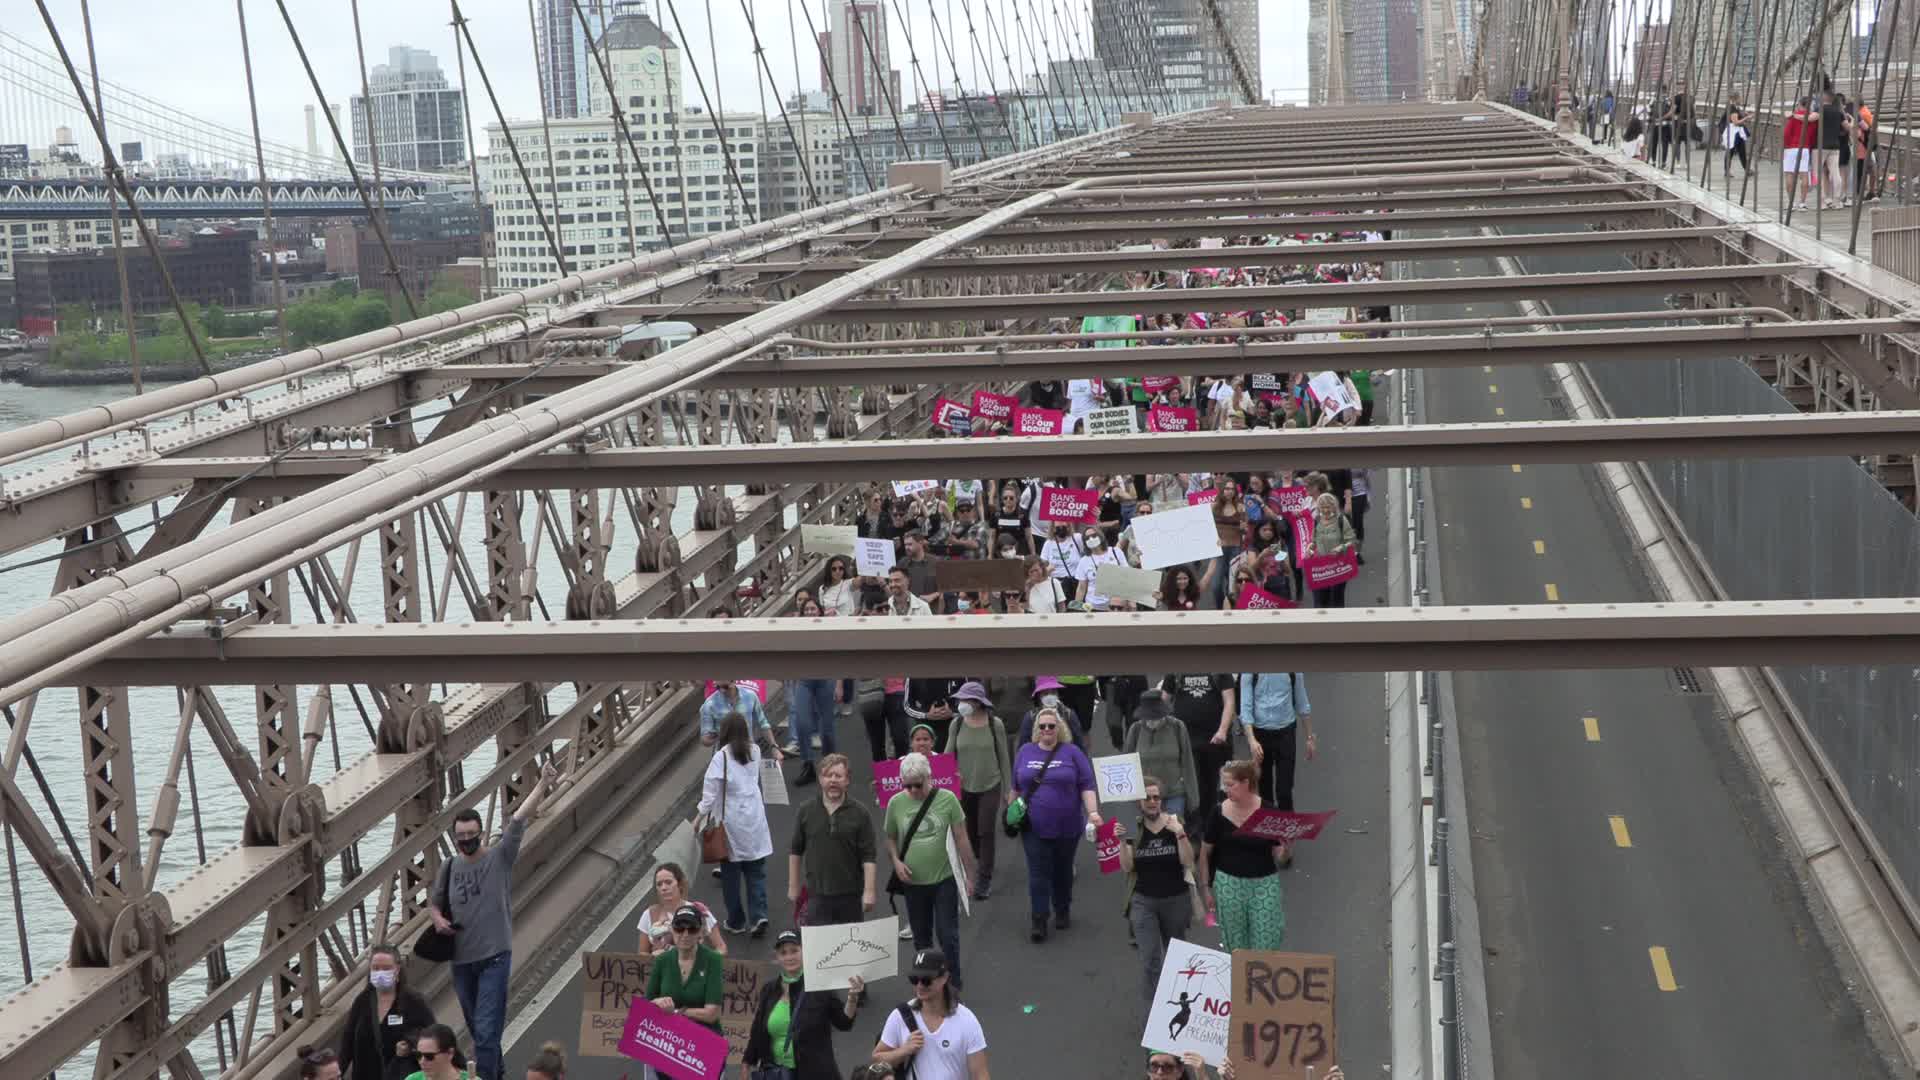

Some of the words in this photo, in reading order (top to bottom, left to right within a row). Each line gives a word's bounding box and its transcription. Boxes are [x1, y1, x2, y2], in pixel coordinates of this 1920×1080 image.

[980, 407, 1008, 416] BODIES
[1021, 412, 1043, 421] BANS
[1089, 411, 1103, 419] OUR
[1105, 409, 1129, 417] BODIES
[1036, 420, 1054, 428] OUR
[1090, 421, 1104, 429] OUR
[1105, 419, 1130, 428] CHOICE
[1051, 493, 1075, 502] BANS
[1281, 491, 1303, 499] BANS
[1050, 500, 1067, 508] OFF
[1068, 502, 1089, 511] OUR
[1049, 508, 1084, 517] BODIES
[1312, 569, 1336, 579] Health
[1251, 593, 1280, 608] BANS
[818, 939, 851, 967] never
[915, 952, 925, 965] N
[1245, 960, 1330, 1004] ROE
[1203, 997, 1232, 1017] NO
[639, 1018, 686, 1049] Abortion
[687, 1039, 697, 1052] is
[1242, 1020, 1328, 1068] 1973
[636, 1029, 675, 1056] Health
[677, 1049, 707, 1071] Care.
